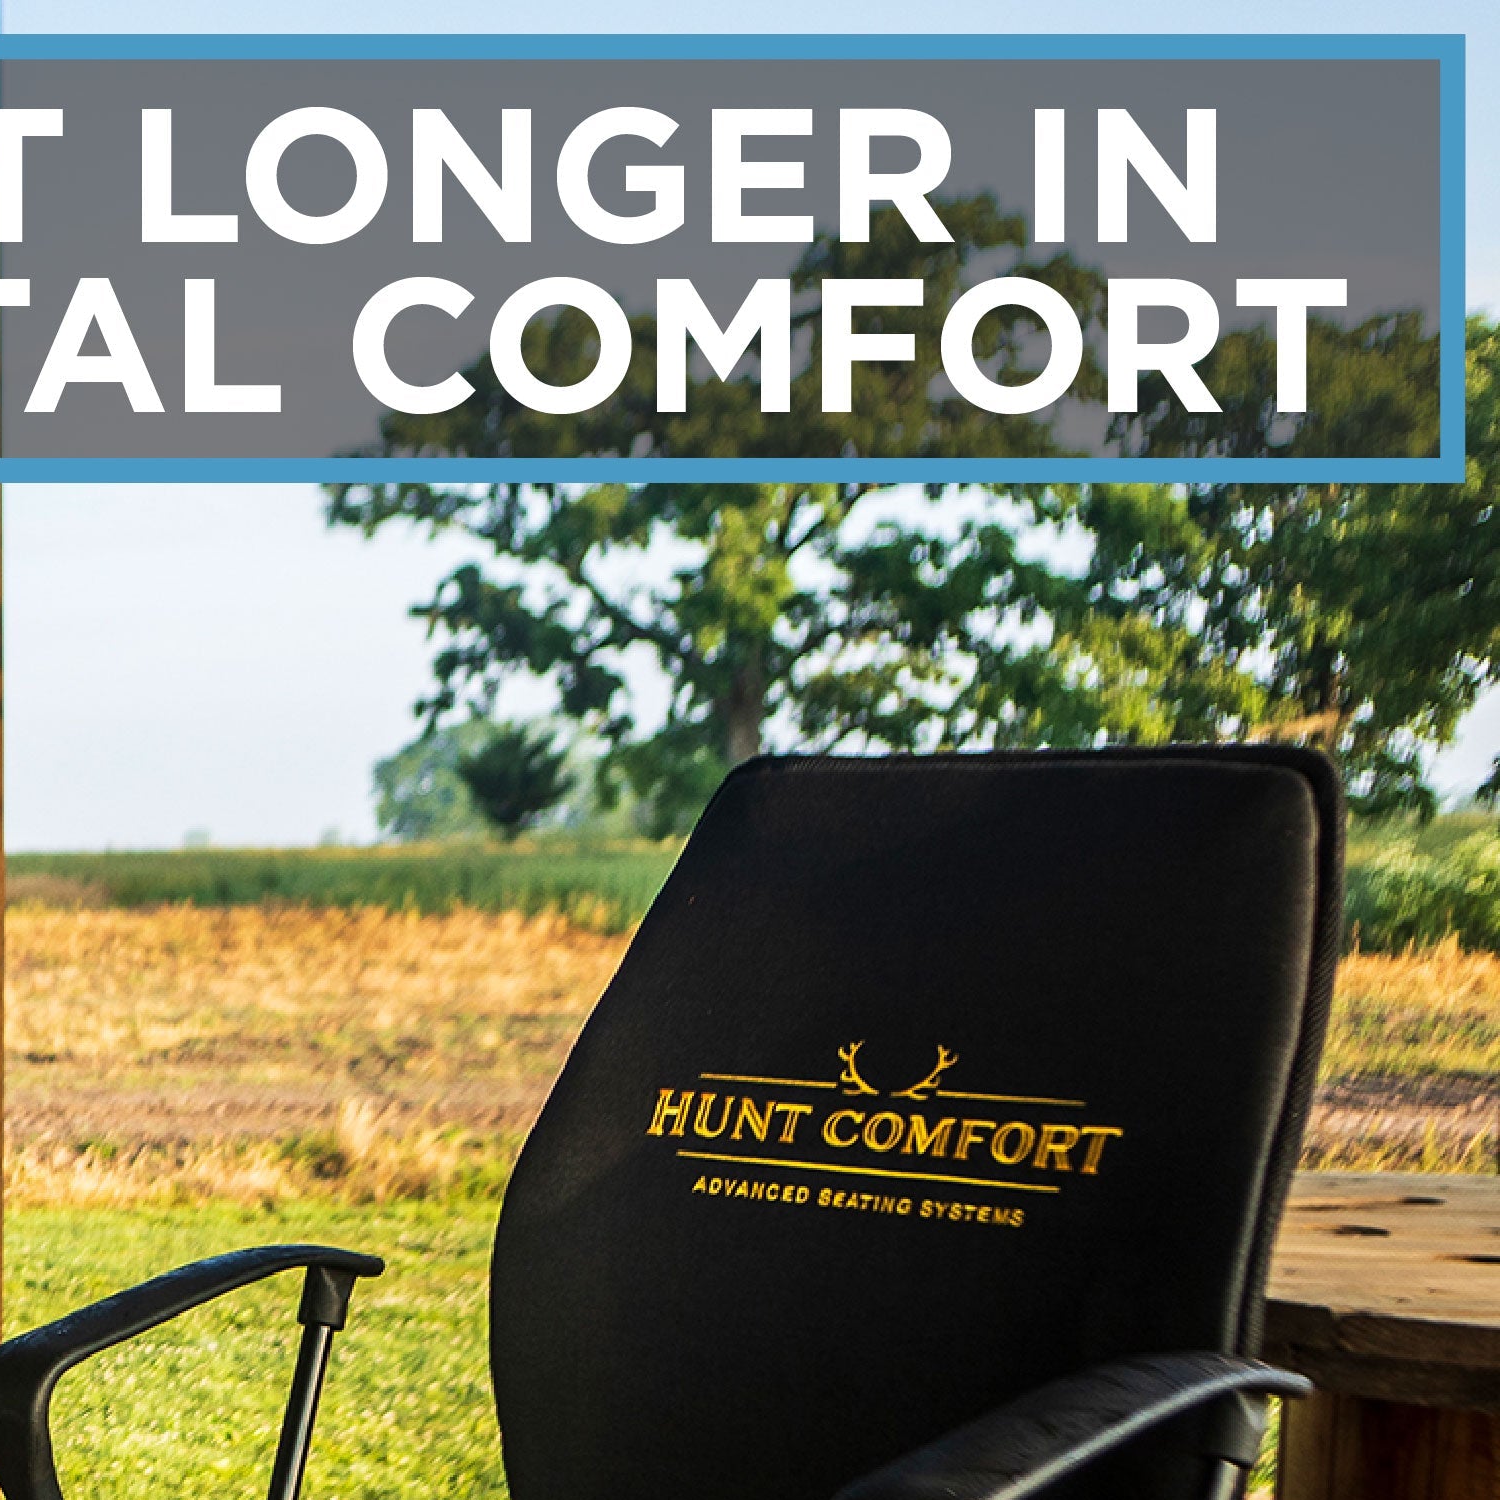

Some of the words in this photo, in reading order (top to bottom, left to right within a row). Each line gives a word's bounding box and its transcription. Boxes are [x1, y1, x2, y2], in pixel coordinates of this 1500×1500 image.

[646, 1087, 814, 1144] HUNT
[820, 1108, 1124, 1175] COMFORT
[691, 1175, 811, 1205] ADVANCED
[816, 1187, 912, 1216] SEATING
[919, 1199, 1025, 1228] SYSTEMS
